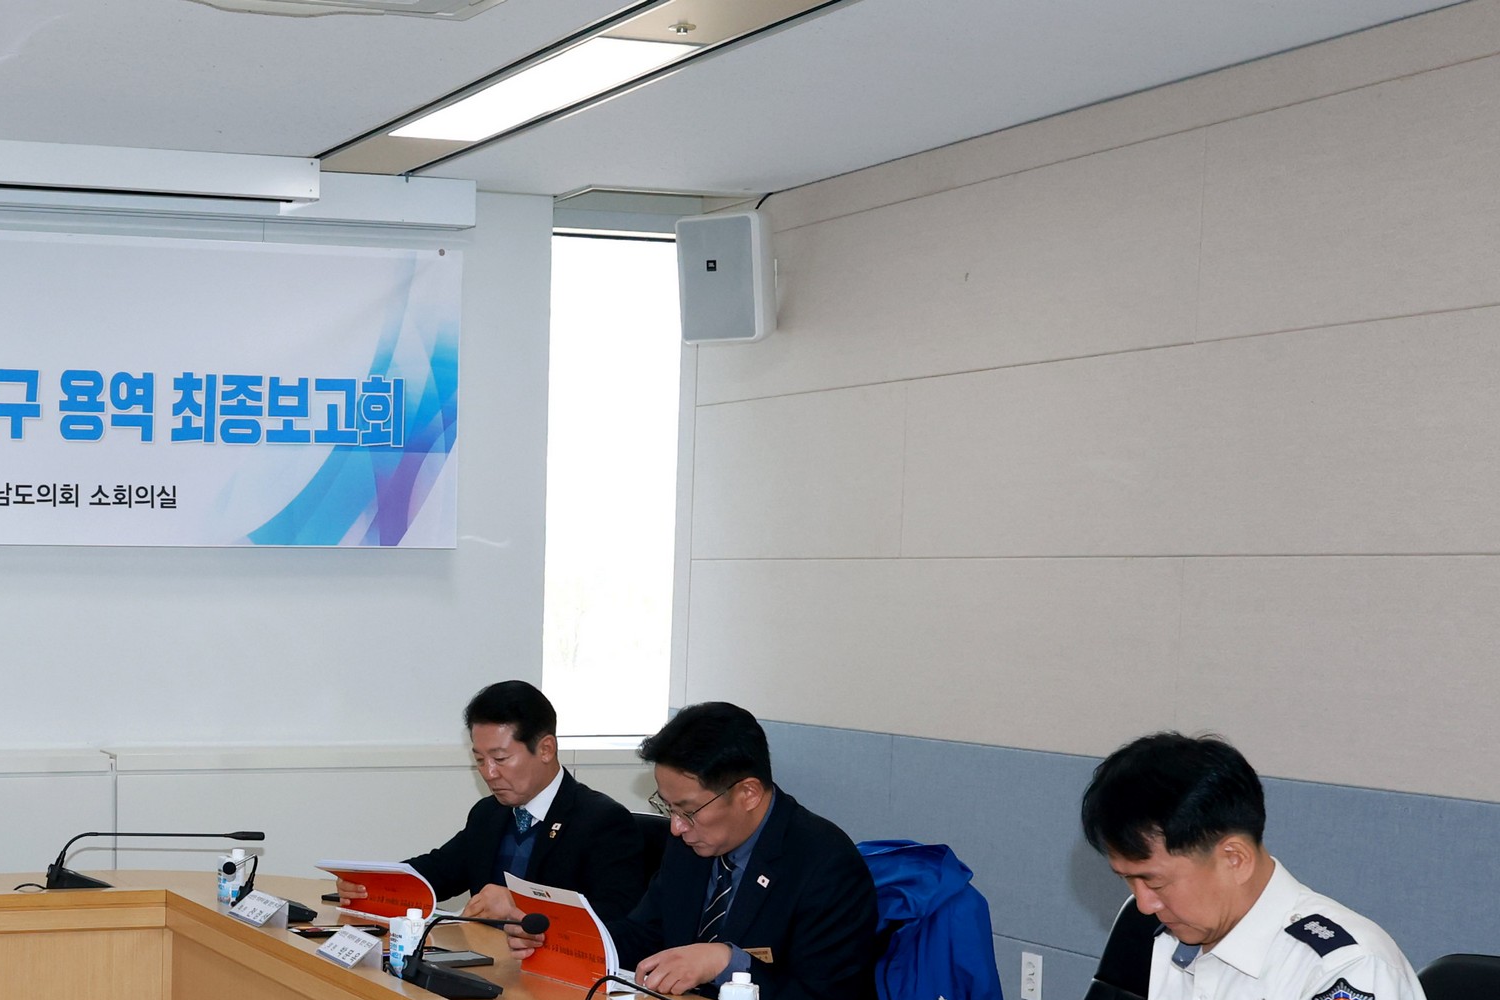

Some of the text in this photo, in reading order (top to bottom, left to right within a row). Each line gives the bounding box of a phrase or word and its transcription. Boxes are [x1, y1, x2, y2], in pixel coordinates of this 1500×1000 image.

[58, 369, 155, 443] 용역
[171, 372, 406, 448] 최종보고회
[88, 484, 177, 509] 소회의실
